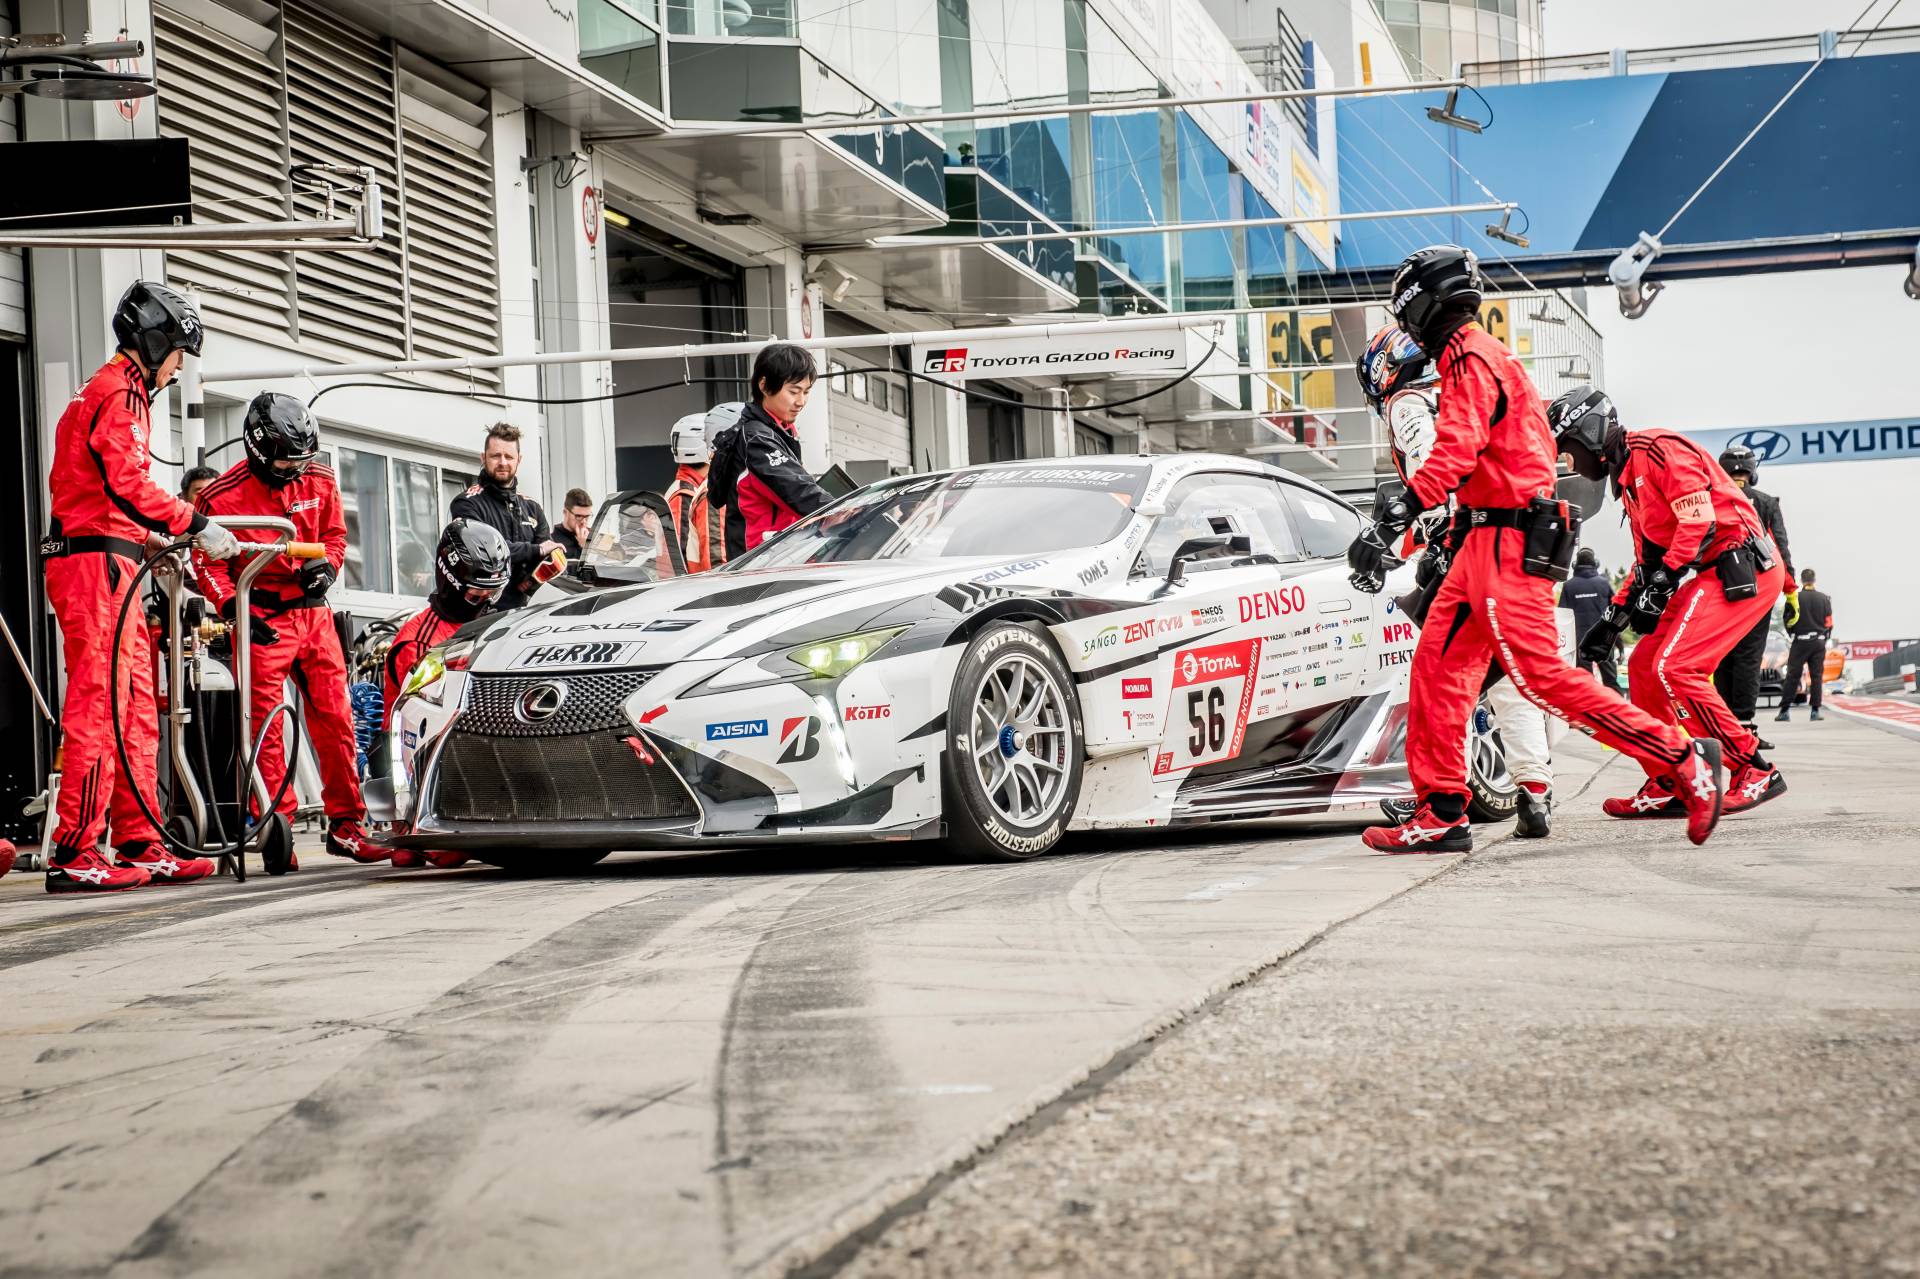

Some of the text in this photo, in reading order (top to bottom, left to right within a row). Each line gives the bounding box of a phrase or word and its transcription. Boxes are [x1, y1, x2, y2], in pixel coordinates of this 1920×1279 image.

[1393, 281, 1423, 315] uvex
[925, 348, 1175, 373] GR TOYOTA GAZOO Racing
[1551, 401, 1591, 438] uvex
[1025, 469, 1124, 482] TURISMO
[1692, 508, 1701, 518] 4
[437, 556, 463, 591] uvex
[1077, 560, 1109, 587] TOM'S
[1200, 605, 1224, 617] ENEOS
[1238, 585, 1305, 623] DENSO
[552, 622, 644, 633] LEXUS
[1124, 619, 1155, 644] ZENT
[1383, 622, 1414, 643] NPR
[977, 629, 1051, 664] POTENZA
[1084, 633, 1117, 652] SANGO
[1855, 646, 1888, 656] TOTAL
[1200, 655, 1241, 673] TOTAL
[1379, 649, 1414, 671] JTEKT
[1231, 640, 1259, 755] ADAC NORDRHEIN
[711, 723, 764, 738] AISIN
[1188, 686, 1226, 757] 56
[983, 816, 1061, 852] BRIDGESTONE
